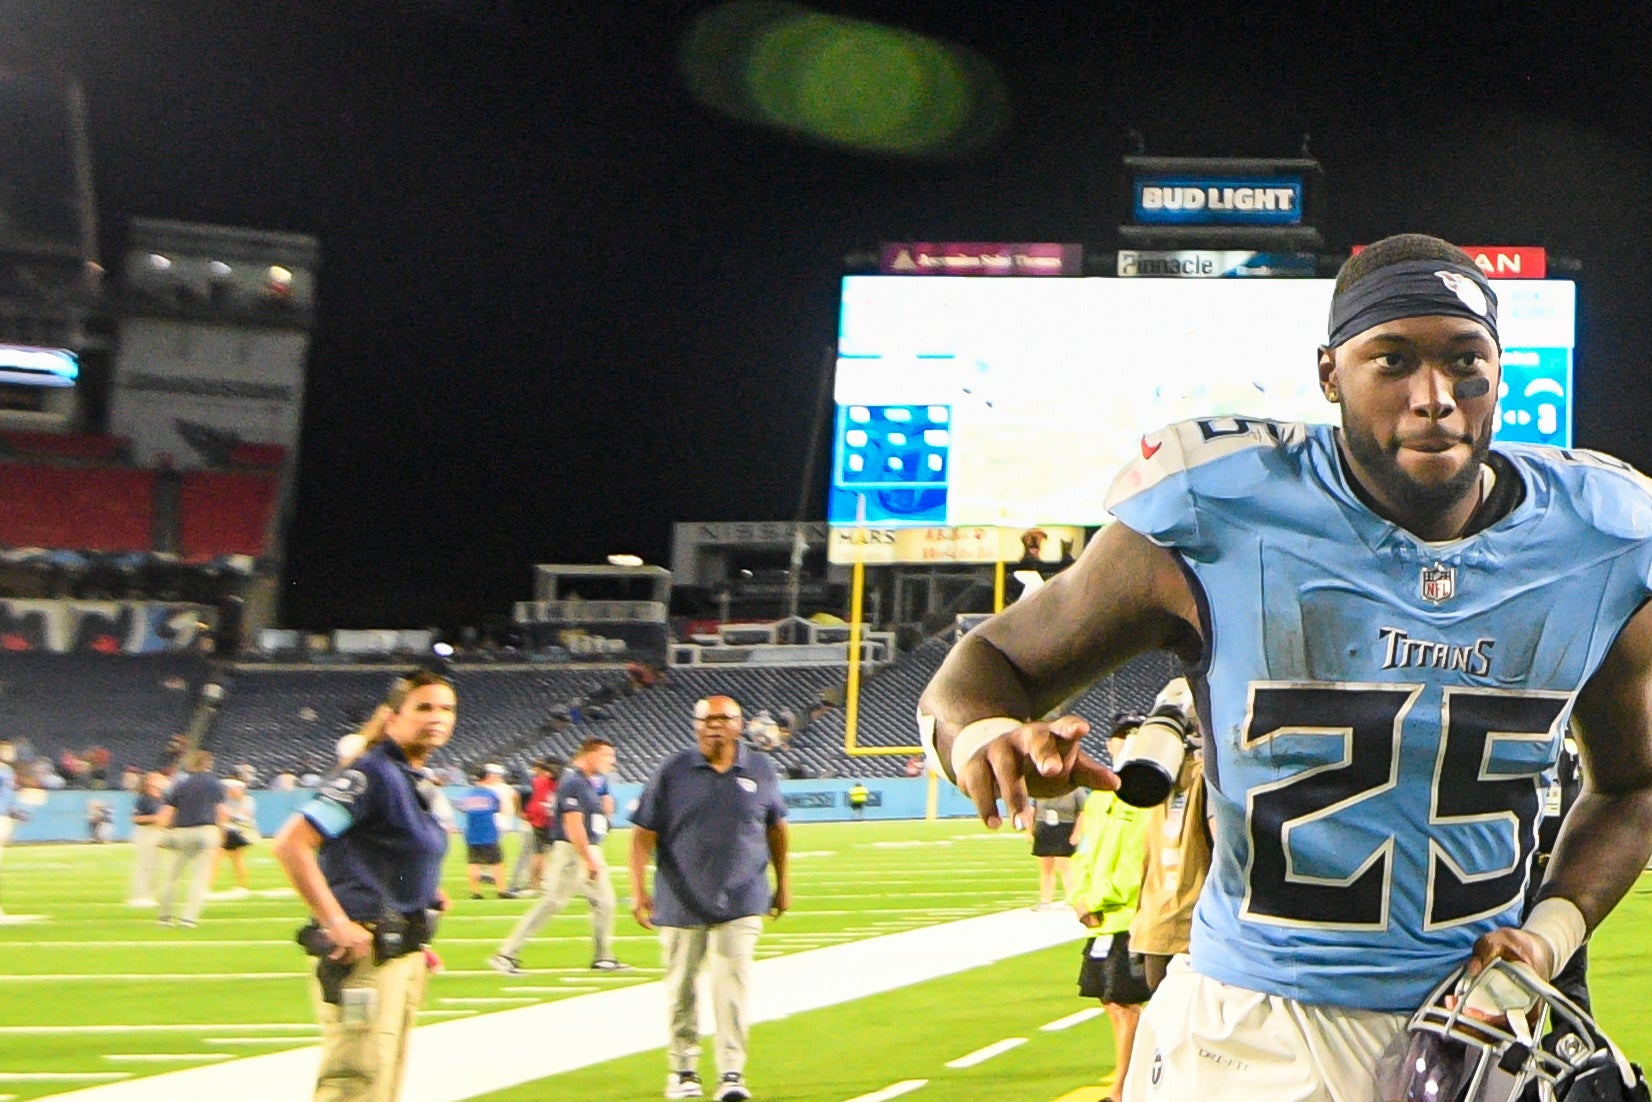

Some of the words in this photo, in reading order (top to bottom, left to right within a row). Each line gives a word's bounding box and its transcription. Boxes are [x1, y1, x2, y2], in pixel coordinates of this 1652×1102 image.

[1142, 187, 1205, 209] BUD
[1207, 188, 1294, 210] LIGHT
[1122, 253, 1213, 275] Pinnacle
[1379, 626, 1496, 677] TITANS
[1238, 681, 1576, 932] 25
